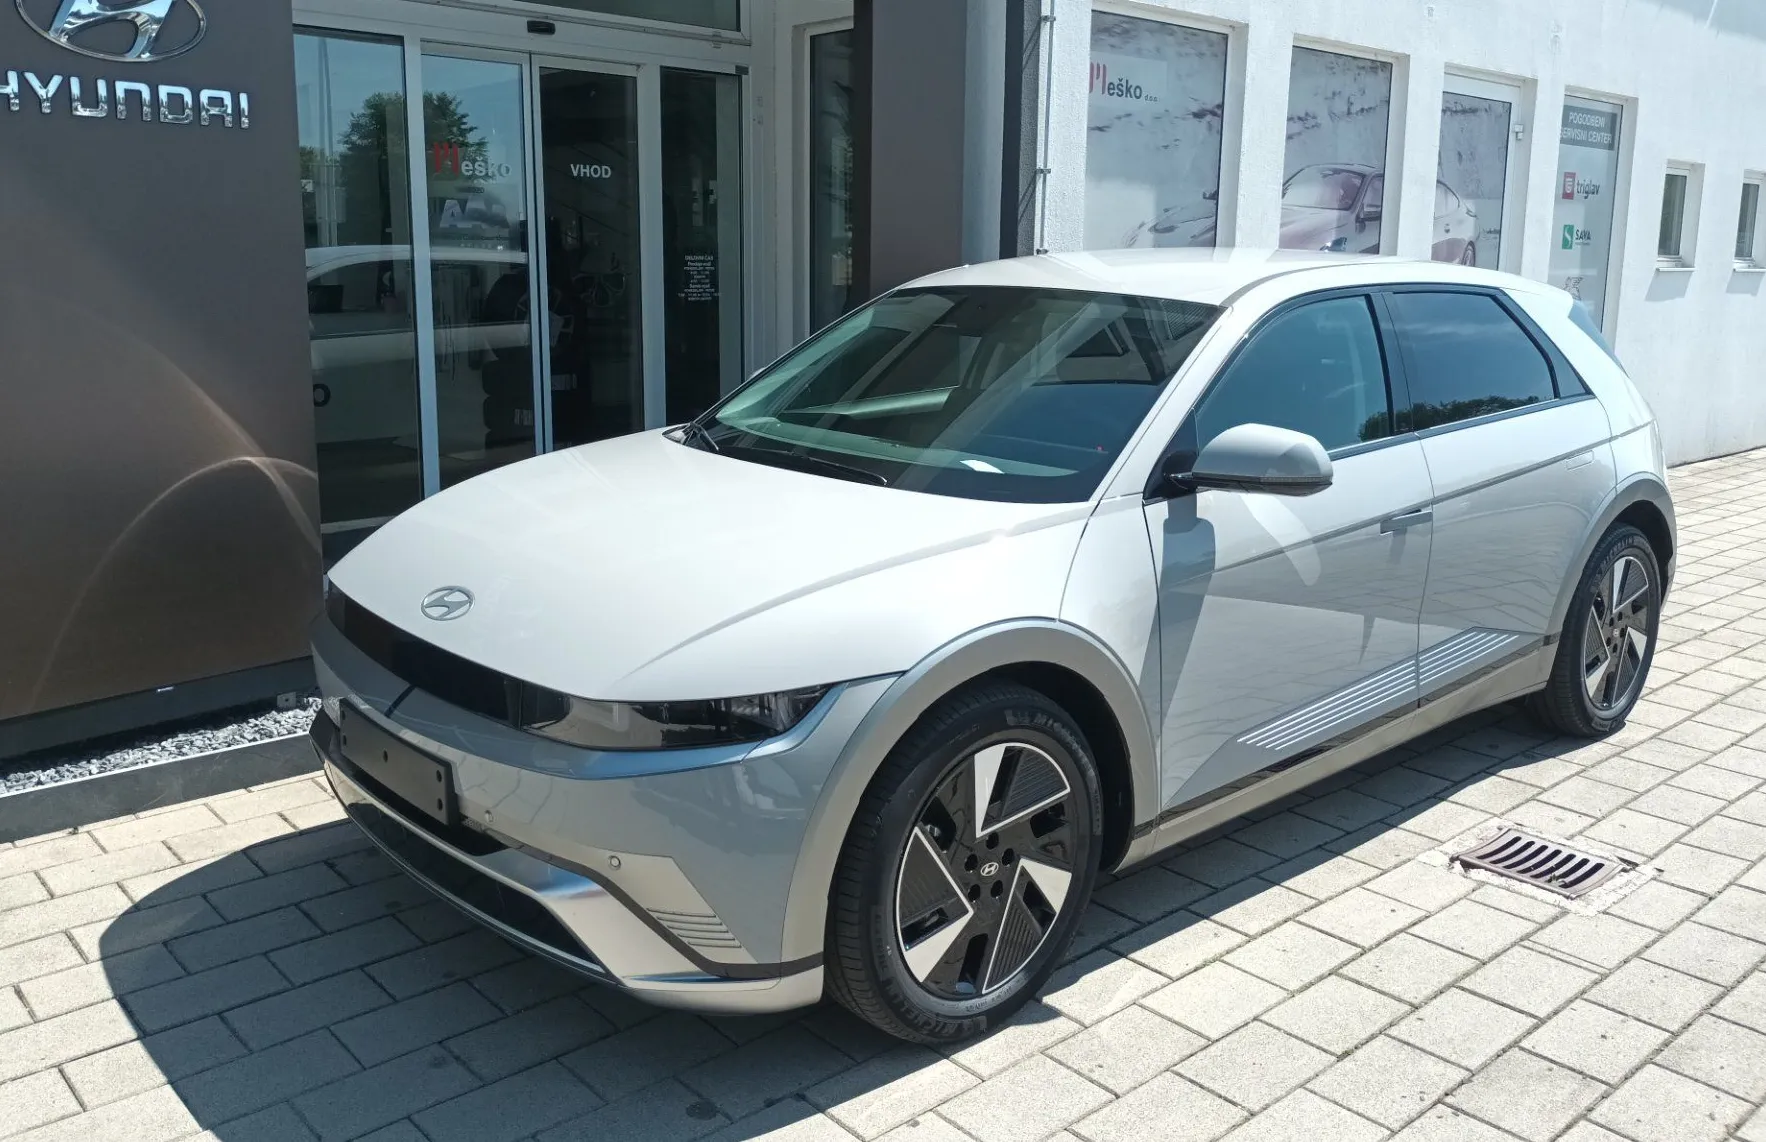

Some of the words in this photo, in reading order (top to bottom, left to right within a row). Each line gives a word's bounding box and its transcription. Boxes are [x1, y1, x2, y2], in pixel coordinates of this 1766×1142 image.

[1568, 111, 1606, 128] POGODBENI
[1588, 130, 1612, 144] CENTER
[570, 163, 612, 178] VHOD
[1576, 180, 1601, 200] triglav
[1575, 229, 1591, 241] SAVA
